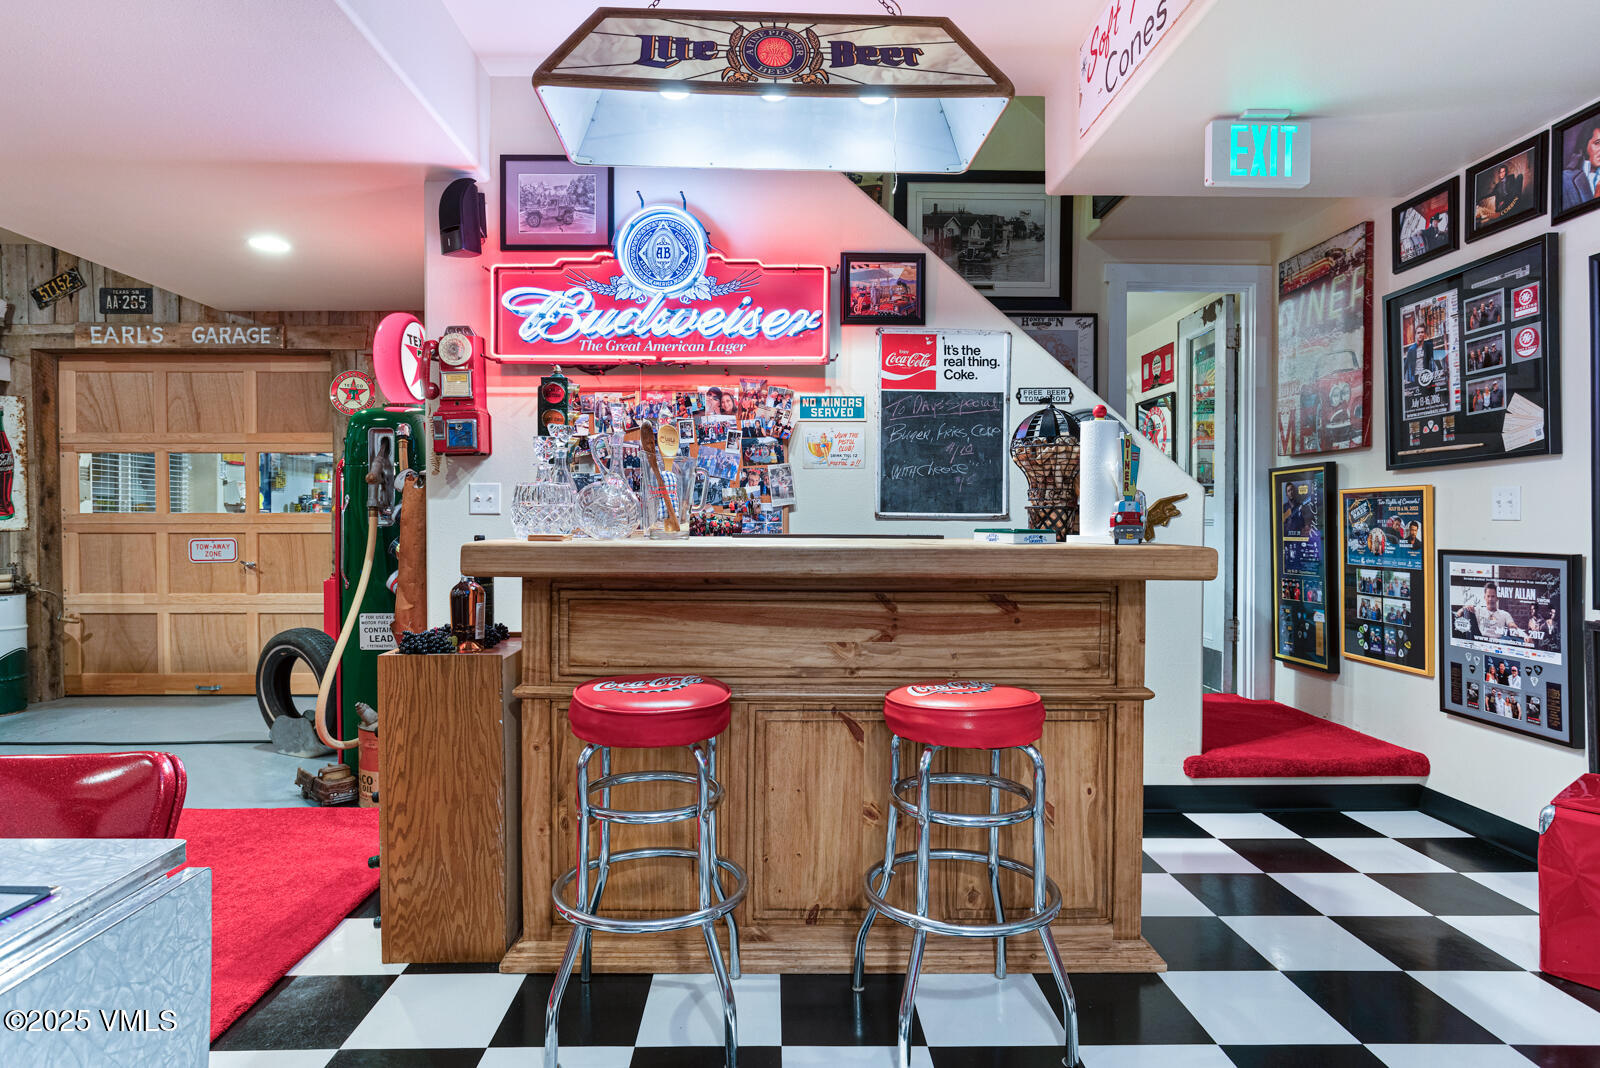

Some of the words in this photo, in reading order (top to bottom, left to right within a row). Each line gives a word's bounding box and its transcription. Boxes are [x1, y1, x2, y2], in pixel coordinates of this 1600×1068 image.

[768, 30, 804, 57] PILSNER
[1105, 0, 1167, 92] Cones
[633, 34, 718, 69] Lite
[828, 40, 924, 69] Beer
[757, 65, 794, 75] BEER
[1230, 124, 1298, 177] EXIT
[656, 246, 671, 259] AB
[501, 286, 823, 342] Budweiser
[90, 325, 164, 345] EARL'S
[191, 326, 272, 345] GARAGE
[407, 333, 422, 348] TEX
[579, 339, 603, 352] The
[605, 339, 641, 352] Great
[643, 339, 705, 352] American
[708, 339, 747, 355] Lager
[943, 345, 960, 356] It's
[962, 345, 981, 356] the
[885, 351, 933, 368] Coca-Cola
[943, 356, 966, 367] real
[968, 356, 1000, 369] thing.
[943, 369, 978, 380] Coke.
[802, 397, 817, 407] NO
[821, 397, 862, 408] MINORS
[810, 407, 854, 417] SERVED
[195, 543, 231, 551] TOW-AWAY
[1496, 586, 1514, 599] GARY
[1514, 587, 1536, 600] ALLAN
[369, 634, 394, 643] LEAD
[593, 675, 704, 692] Coca-Cola
